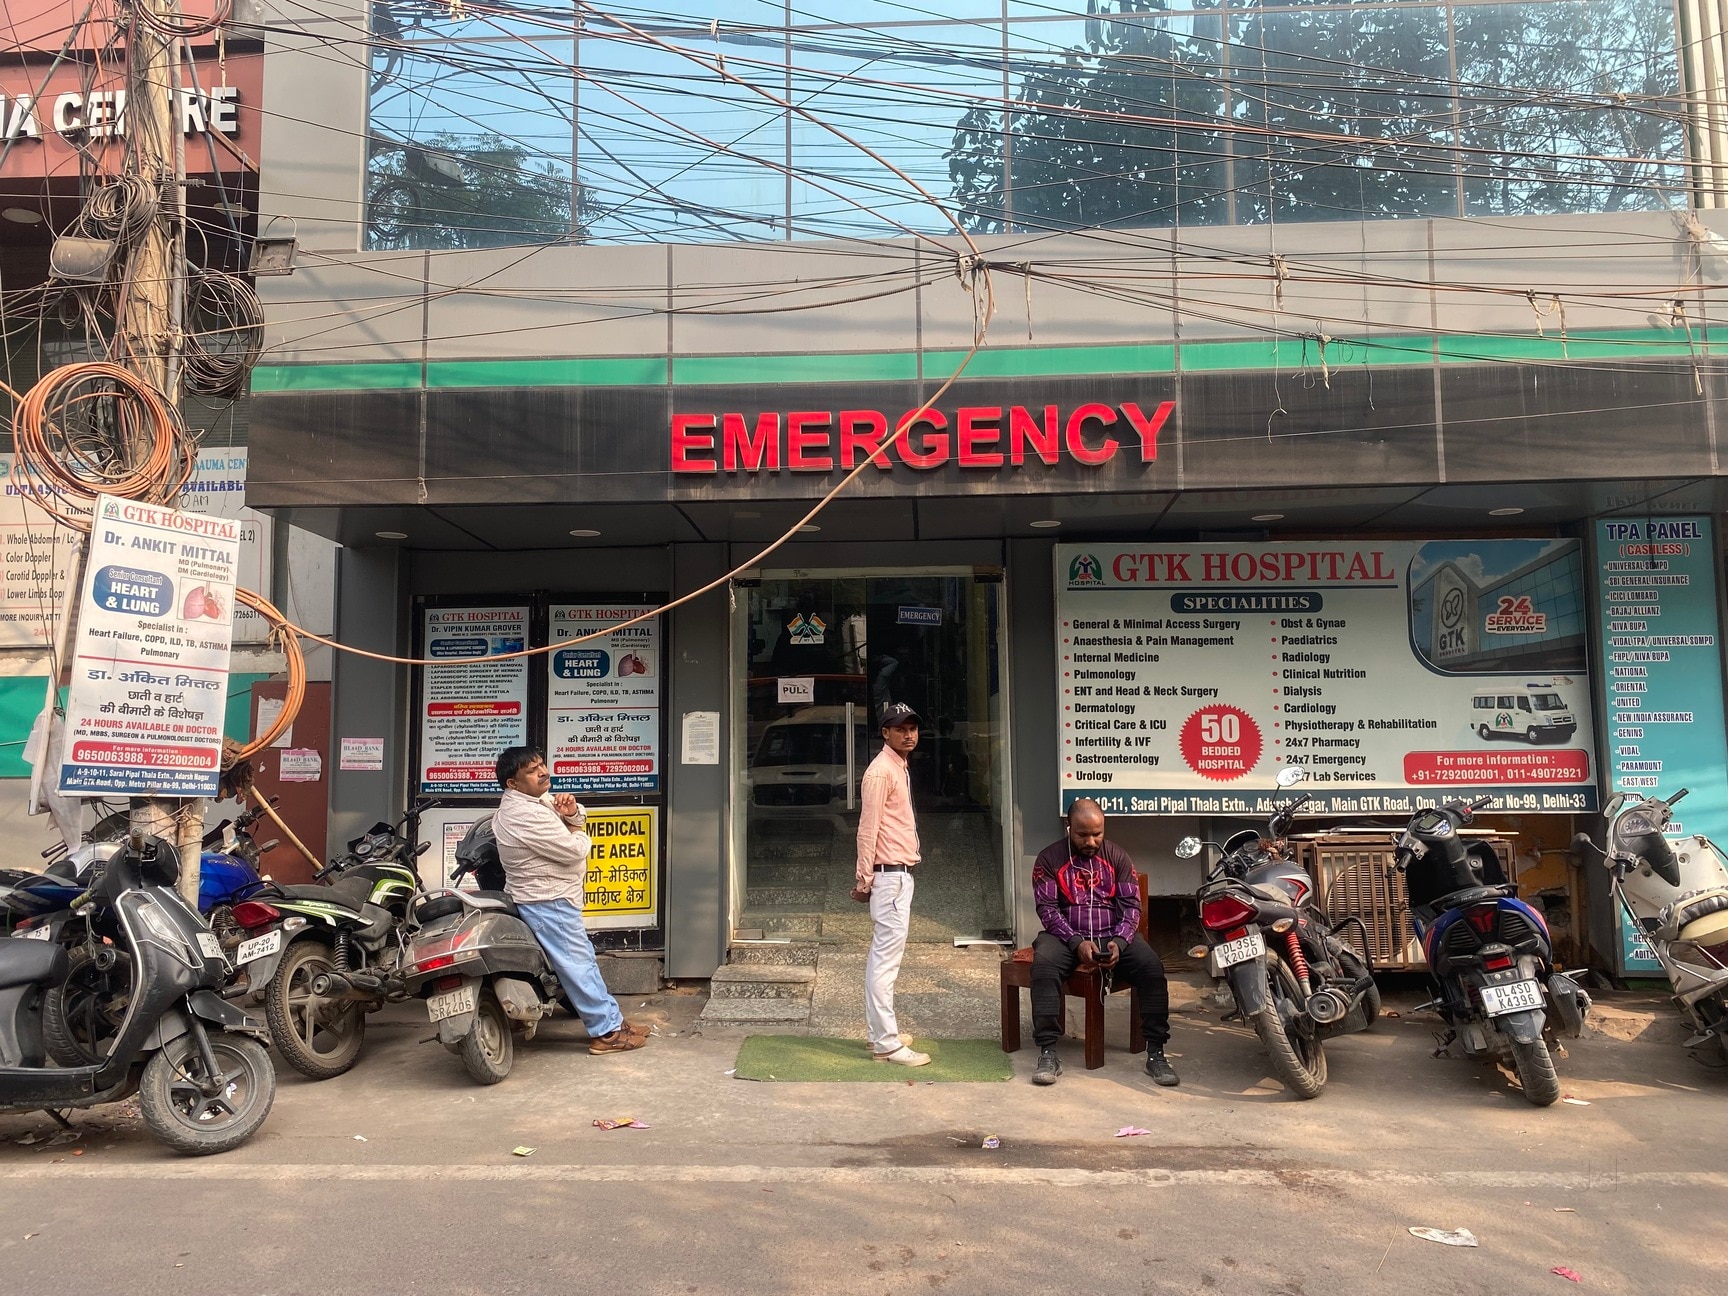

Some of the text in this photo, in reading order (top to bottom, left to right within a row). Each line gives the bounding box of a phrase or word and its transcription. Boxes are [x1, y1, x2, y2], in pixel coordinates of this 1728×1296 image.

[53, 87, 237, 136] CERE
[672, 401, 1176, 473] EMERGENCY
[124, 506, 237, 539] GTK HOSPITAL
[1607, 523, 1701, 539] TPA PANEL
[7, 534, 60, 545] Whole Abdomen
[104, 531, 233, 564] Dr. ANKIT MITTAL
[6, 554, 51, 566] Color Doppler
[1609, 562, 1643, 570] UNIVERSAL
[191, 560, 229, 573] (Pulmonary)
[1113, 552, 1395, 582] GTK HOSPITAL
[1610, 576, 1688, 585] SBI GENERAL INSURANCE
[111, 582, 158, 598] HEART
[1627, 592, 1657, 600] LOMBARD
[106, 596, 159, 613] & LUNG
[1184, 596, 1310, 610] SPECIALITIES
[1499, 598, 1530, 616] 24
[442, 612, 523, 621] GTK HOSPITAL
[900, 611, 939, 620] EMERGENCY
[1612, 607, 1631, 615] BAJAJ
[1073, 619, 1240, 630] General & Minimal Access Surgery
[1281, 618, 1345, 630] Obst & Gynae
[1488, 615, 1543, 626] SERVICE
[1630, 622, 1646, 630] BUPA
[89, 628, 228, 651] Heart Failure, COPD, ILD, TB, ASTHMA
[1073, 636, 1234, 647] Anaesthesia & Pain Management
[1282, 635, 1337, 645] Paediatrics
[1440, 628, 1464, 650] GTK
[1633, 637, 1645, 645] TPA
[1653, 637, 1688, 645] UNIVERSAL
[1690, 636, 1713, 644] SOMPO
[141, 648, 179, 659] Pulmonary
[1074, 653, 1159, 662] Internal Medicine
[1282, 652, 1330, 664] Radiology
[1074, 670, 1136, 681] Pulmonology
[1283, 669, 1366, 679] Clinical Nutrition
[1615, 668, 1646, 676] NATIONAL
[1074, 686, 1218, 698] ENT and Head & Neck Surgery
[1284, 686, 1322, 698] Dialysis
[1616, 683, 1646, 691] ORIENTAL
[1617, 698, 1640, 706] UNITED
[1075, 703, 1135, 715] Dermatology
[1284, 703, 1336, 715] Cardiology
[1654, 713, 1692, 721] ASSURANCE
[94, 720, 122, 728] HOURS
[126, 722, 169, 732] AVAILABLE
[173, 725, 183, 733] ON
[186, 726, 217, 735] DOCTOR
[1075, 720, 1166, 730] Critical Care & ICU
[1201, 715, 1240, 743] 50
[1285, 718, 1437, 732] Physiotherapy & Rehabilitation
[1619, 729, 1642, 737] GENINS
[1075, 737, 1151, 748] Infertility & IVF
[1286, 737, 1360, 749] 24x7 Pharmacy
[1202, 747, 1240, 756] BEDDED
[1620, 747, 1639, 755] VIDAL
[77, 750, 211, 766] 9650063988, 7292002004
[1076, 754, 1159, 766] Gastroenterology
[1286, 754, 1366, 766] 24x7 Emergency
[1198, 760, 1245, 769] HOSPITAL
[1622, 762, 1661, 770] PARAMOUNT
[1076, 771, 1113, 782] Urology
[1412, 768, 1581, 781] +91-7292002001, 011-49072921
[1623, 778, 1638, 786] EAST
[609, 843, 645, 858] AREA
[248, 938, 270, 950] UP-20
[242, 944, 274, 959] AM-7412
[1499, 994, 1535, 1009] K4396
